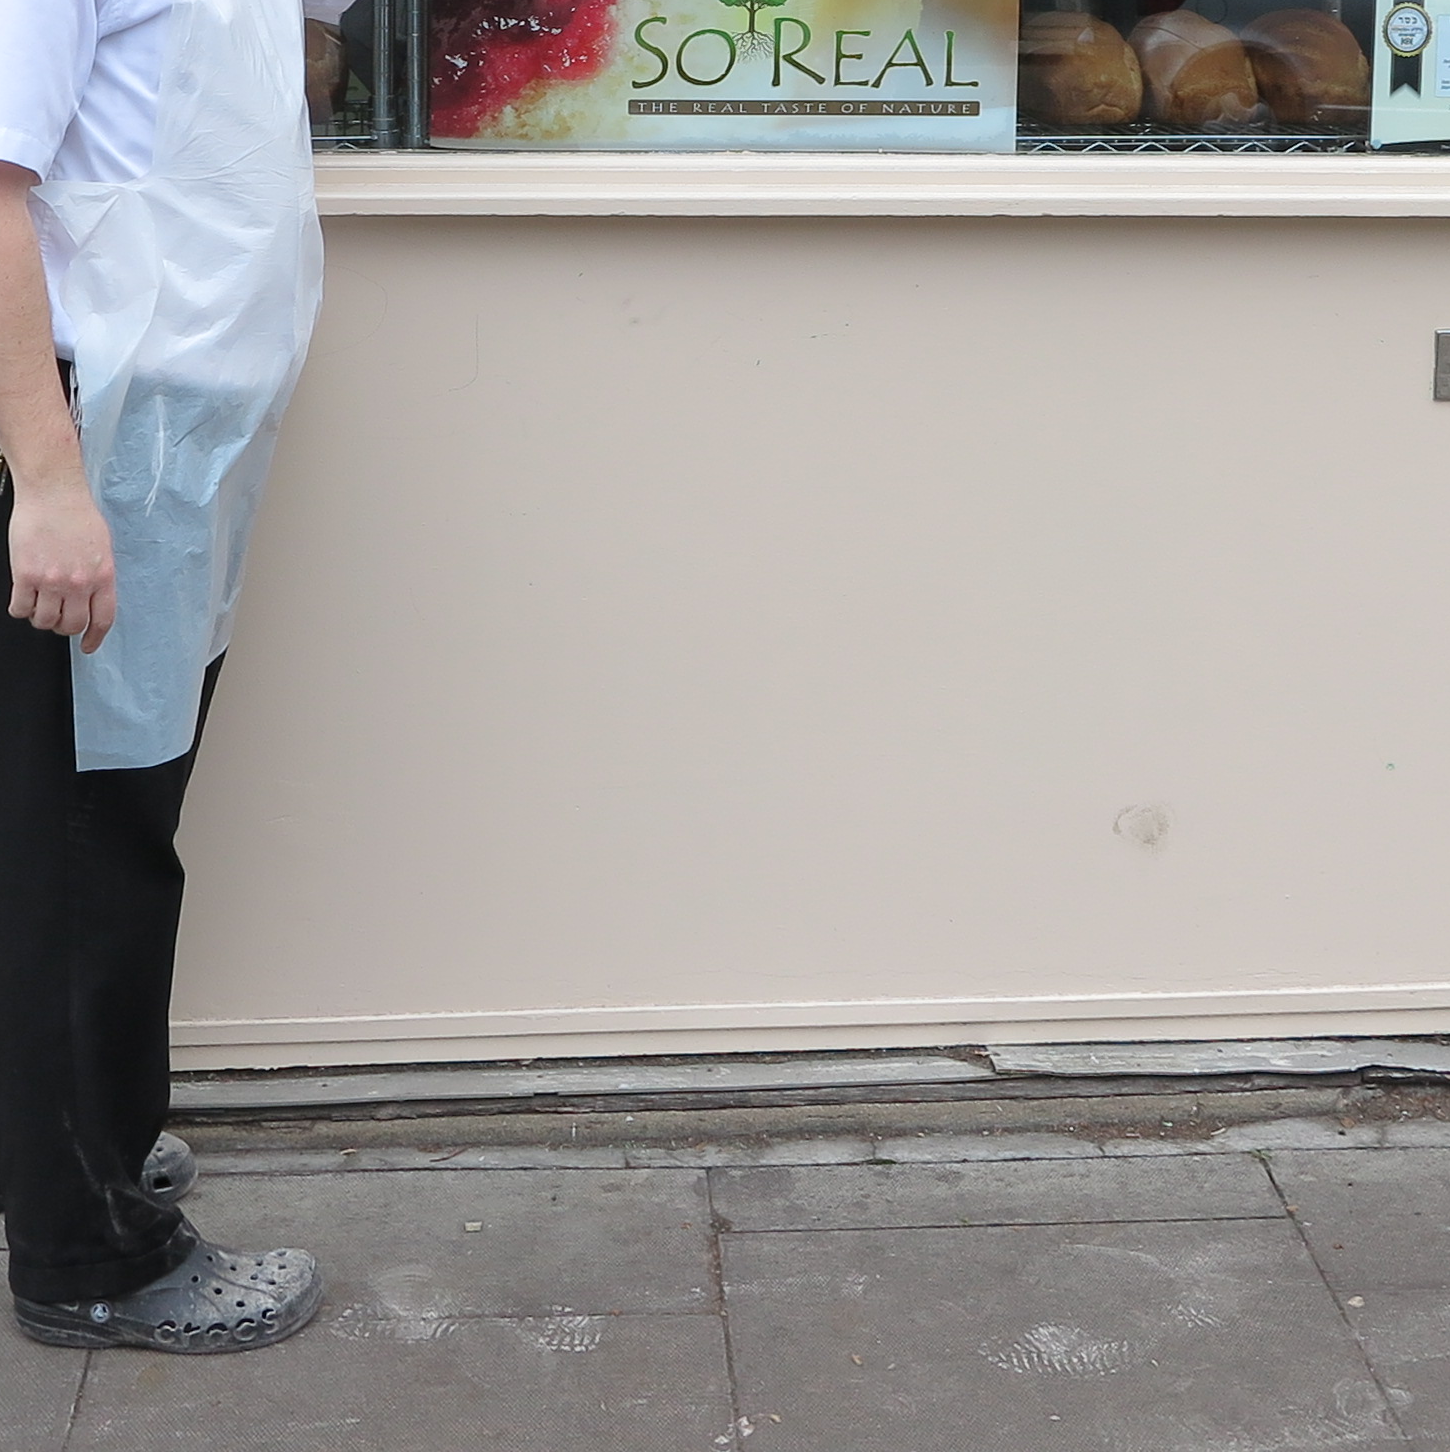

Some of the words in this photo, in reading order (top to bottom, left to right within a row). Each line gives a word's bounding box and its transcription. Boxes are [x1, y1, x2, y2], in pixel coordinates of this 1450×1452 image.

[631, 16, 736, 89] SO
[771, 17, 979, 89] REAL
[638, 102, 678, 114] THE
[693, 102, 747, 114] REAL
[761, 102, 827, 114] TASTE
[841, 102, 868, 114] OF
[882, 102, 971, 115] NATURE
[154, 1307, 279, 1346] crocs
